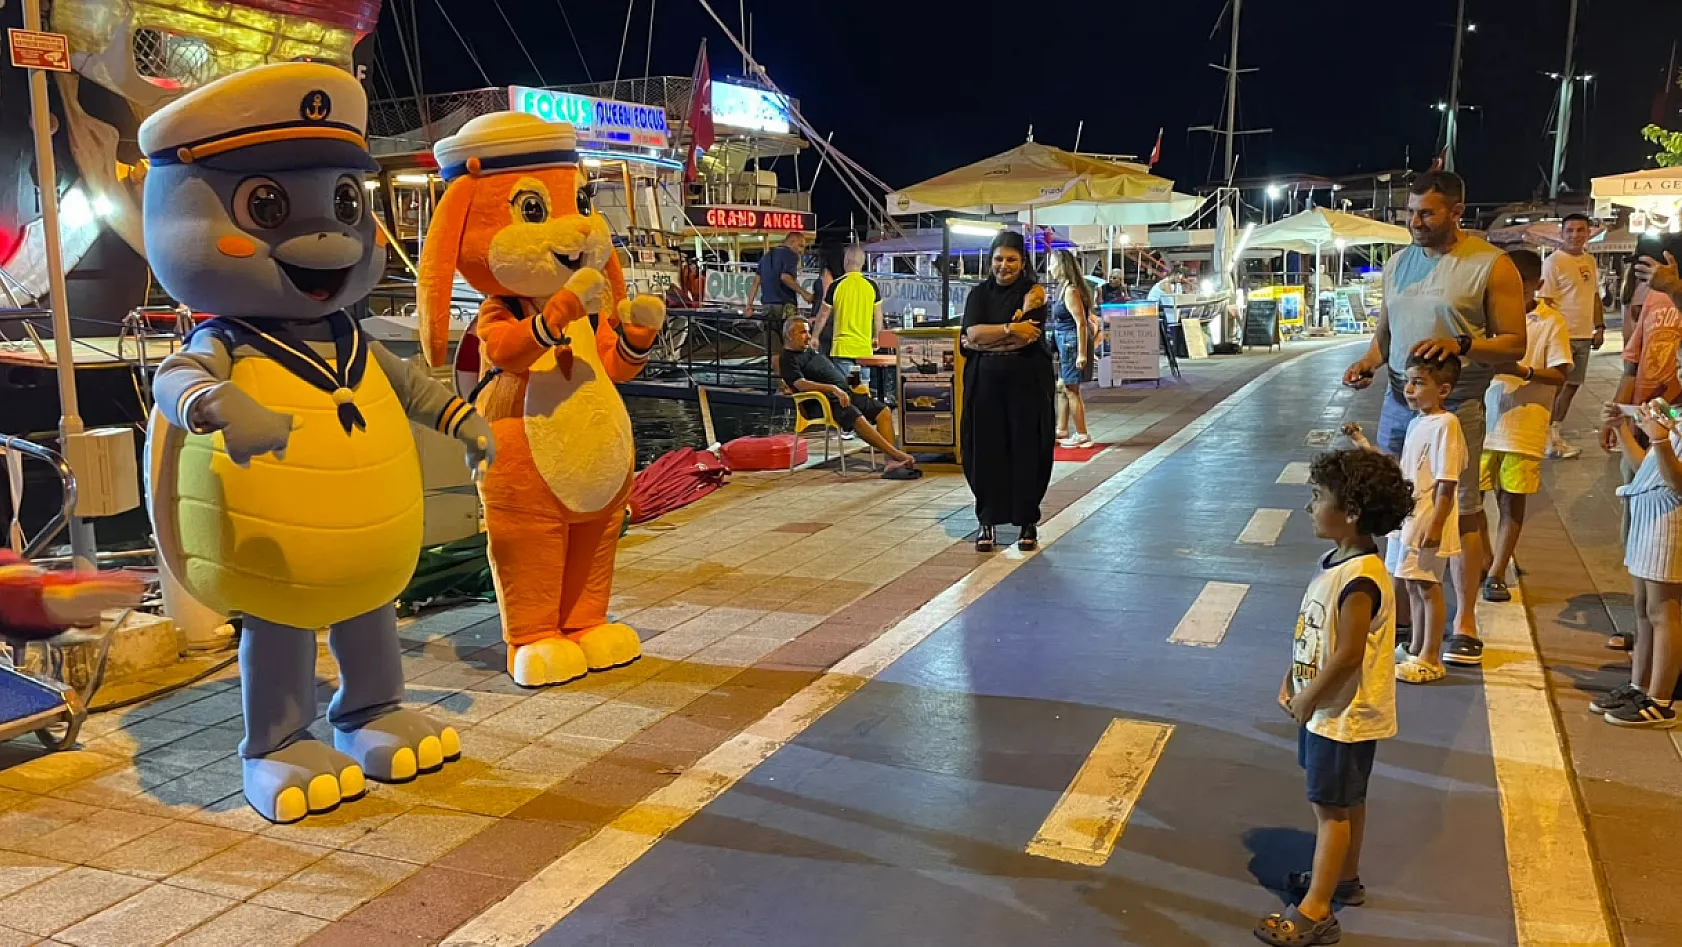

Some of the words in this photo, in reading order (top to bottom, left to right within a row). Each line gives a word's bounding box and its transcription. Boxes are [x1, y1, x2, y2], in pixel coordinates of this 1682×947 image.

[524, 91, 591, 124] FOCUS
[596, 101, 631, 128] QUEEN
[633, 106, 664, 131] FOCUS
[1633, 181, 1653, 190] LA
[1660, 180, 1682, 190] GE
[706, 209, 757, 226] GRAND
[763, 212, 805, 229] ANGEL
[895, 282, 937, 303] SAILING
